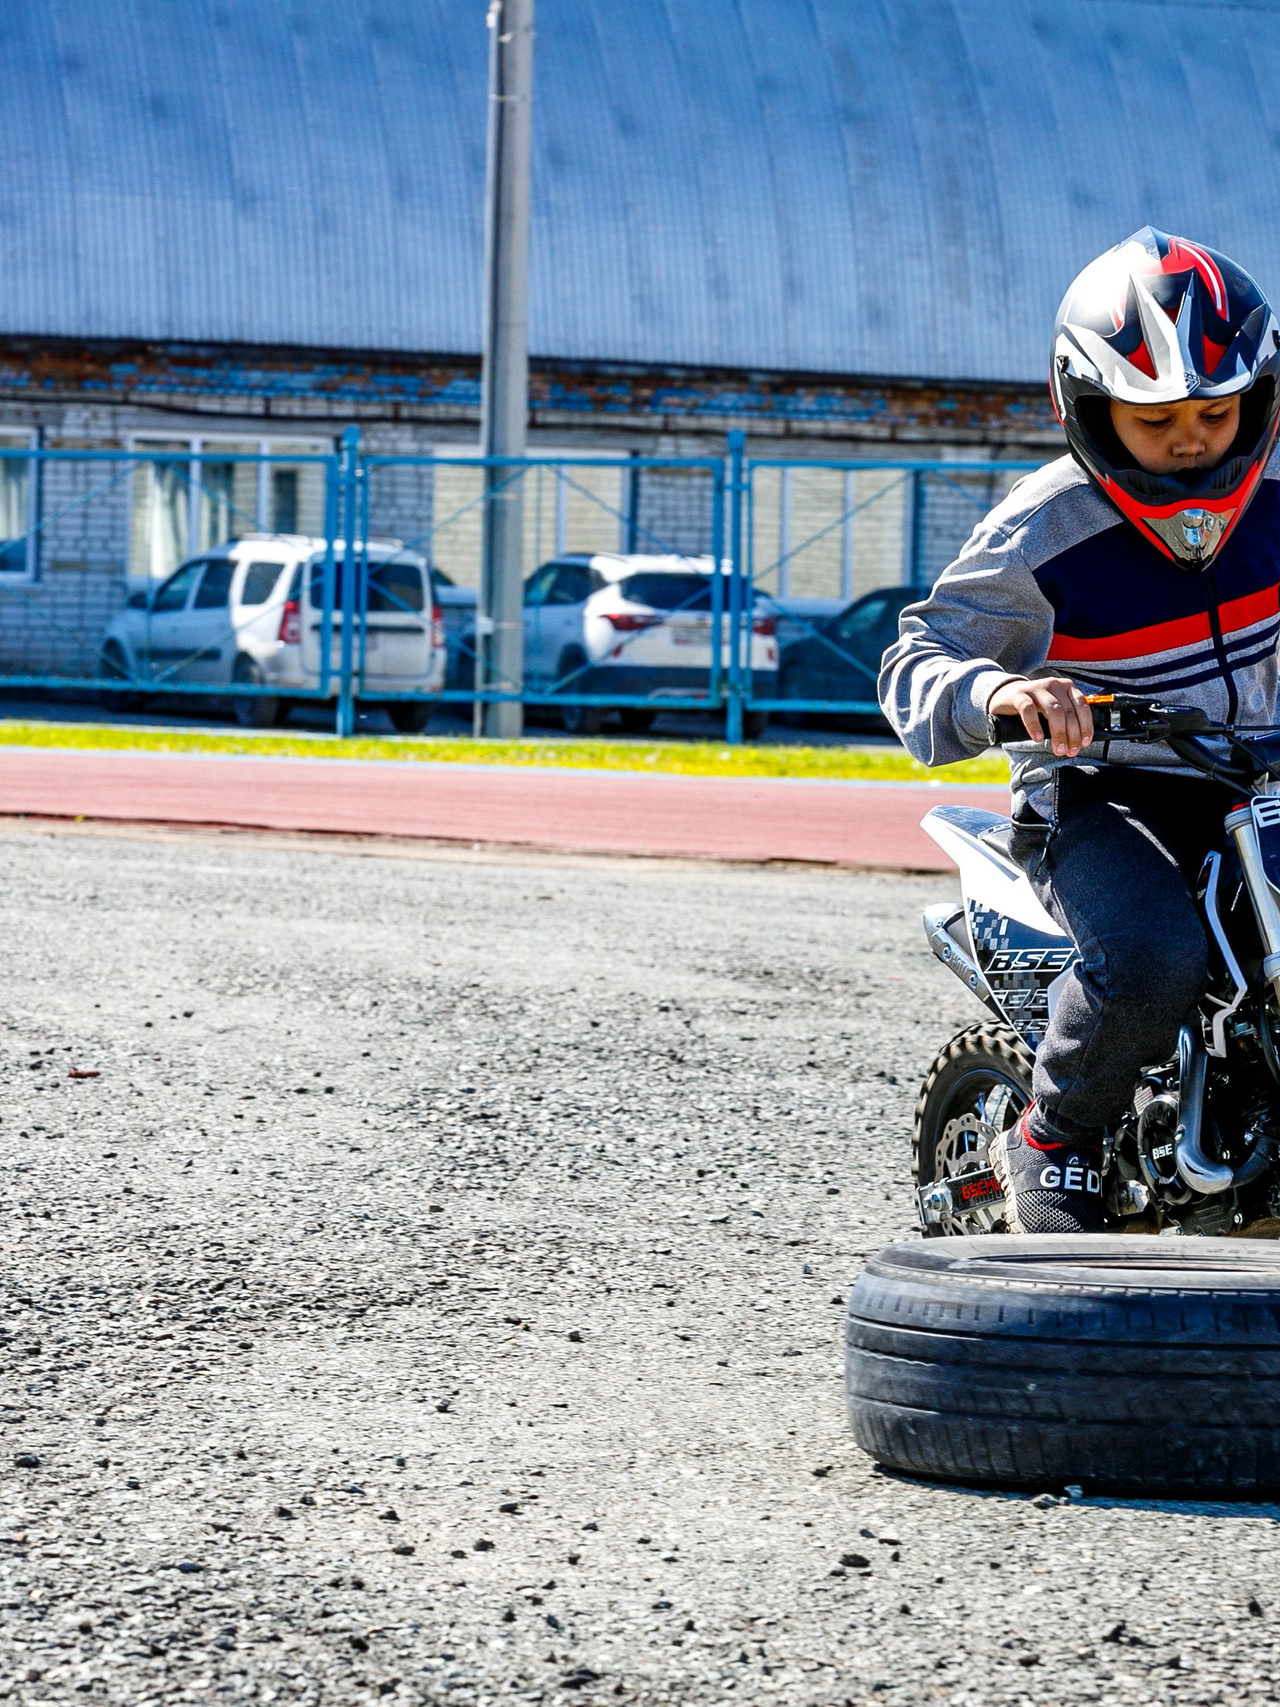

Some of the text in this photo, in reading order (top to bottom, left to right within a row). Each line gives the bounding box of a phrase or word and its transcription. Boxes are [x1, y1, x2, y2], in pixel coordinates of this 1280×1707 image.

[984, 948, 1076, 973] BSE
[1152, 1144, 1173, 1160] BSE
[1040, 1165, 1100, 1193] GED
